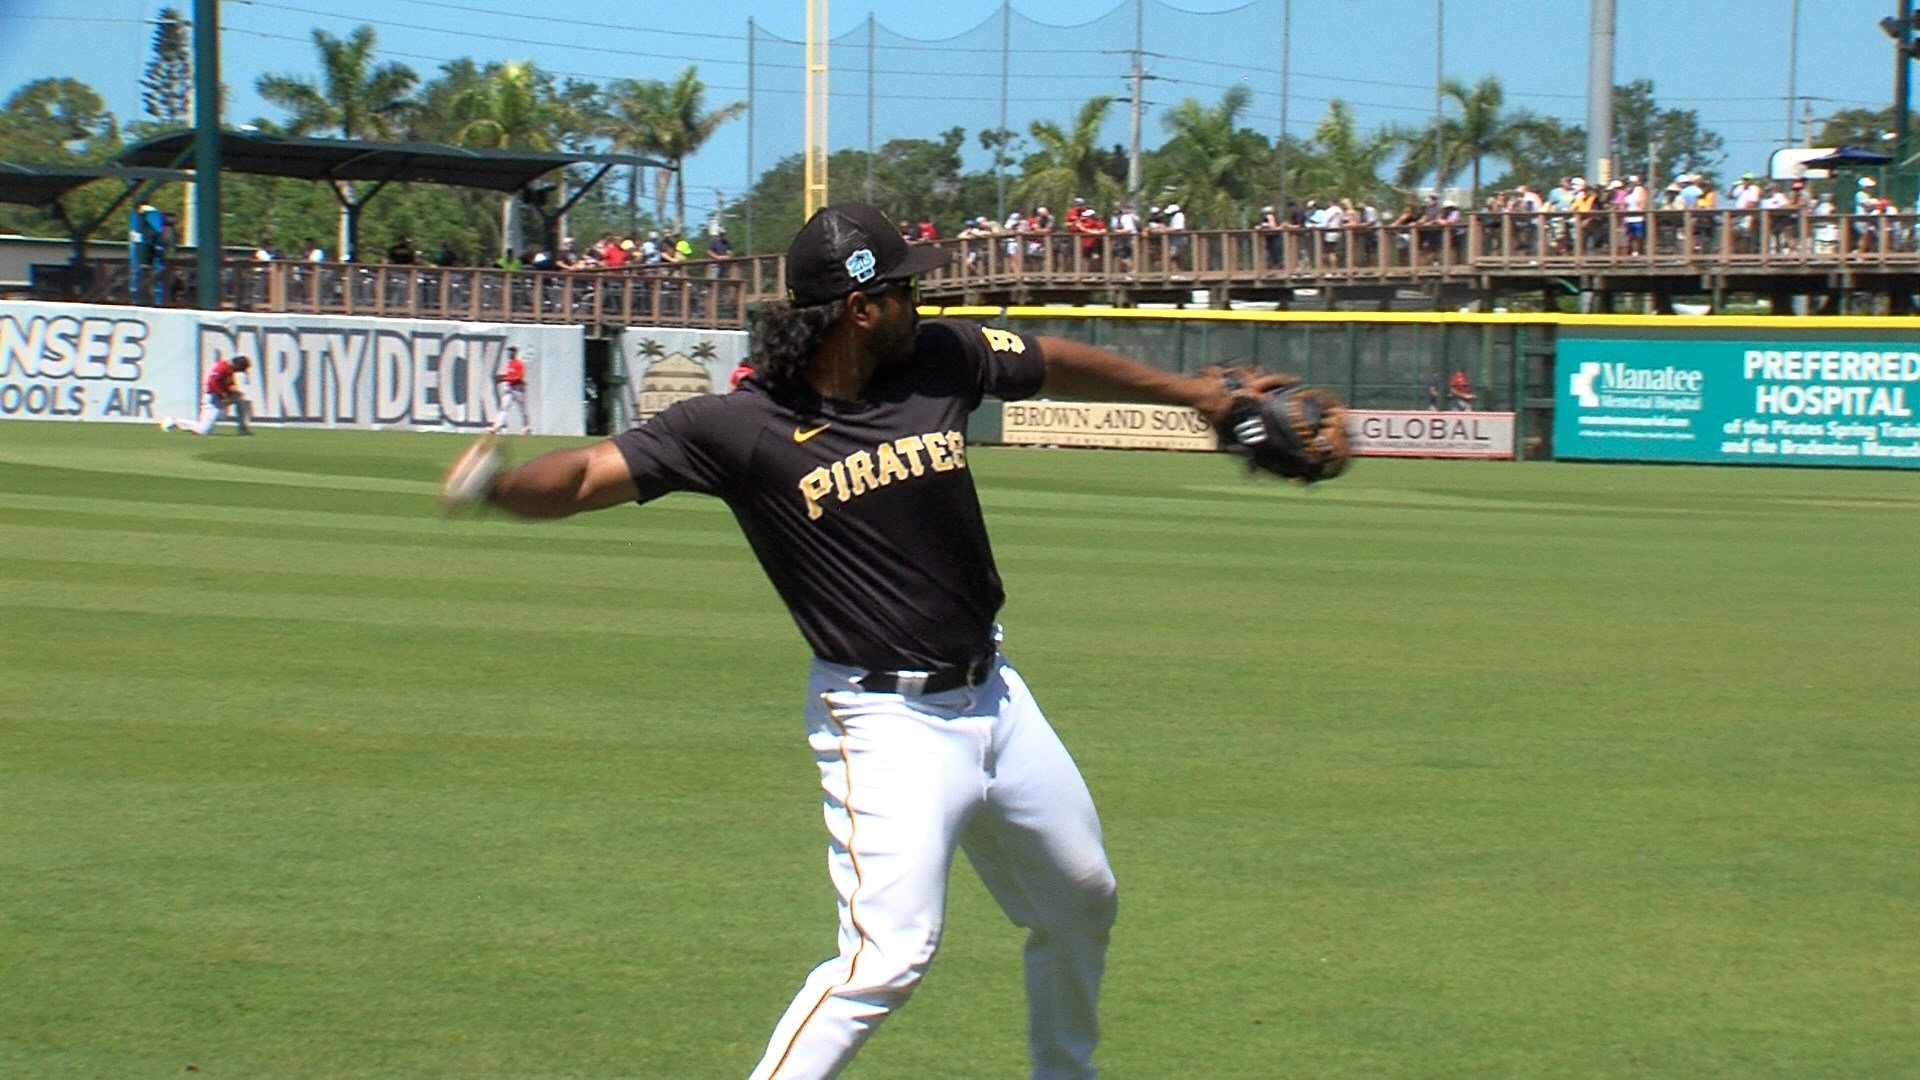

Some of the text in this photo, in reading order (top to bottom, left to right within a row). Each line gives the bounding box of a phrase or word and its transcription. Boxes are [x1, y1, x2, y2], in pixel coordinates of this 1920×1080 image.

[197, 324, 508, 428] PARTY DECK
[1601, 362, 1703, 391] Manatee
[1743, 350, 1920, 381] PREFERRED
[1, 384, 156, 418] OOLS AIR
[1756, 385, 1912, 416] HOSPITAL
[1007, 406, 1210, 434] BROWN AND SONS
[1363, 418, 1490, 441] GLOBAL
[1723, 418, 1742, 434] of
[1743, 418, 1769, 434] the
[1771, 419, 1824, 435] Pirates
[1826, 421, 1878, 440] Spring
[1721, 438, 1750, 453] and
[1751, 438, 1778, 453] the
[799, 429, 967, 520] PIRATES
